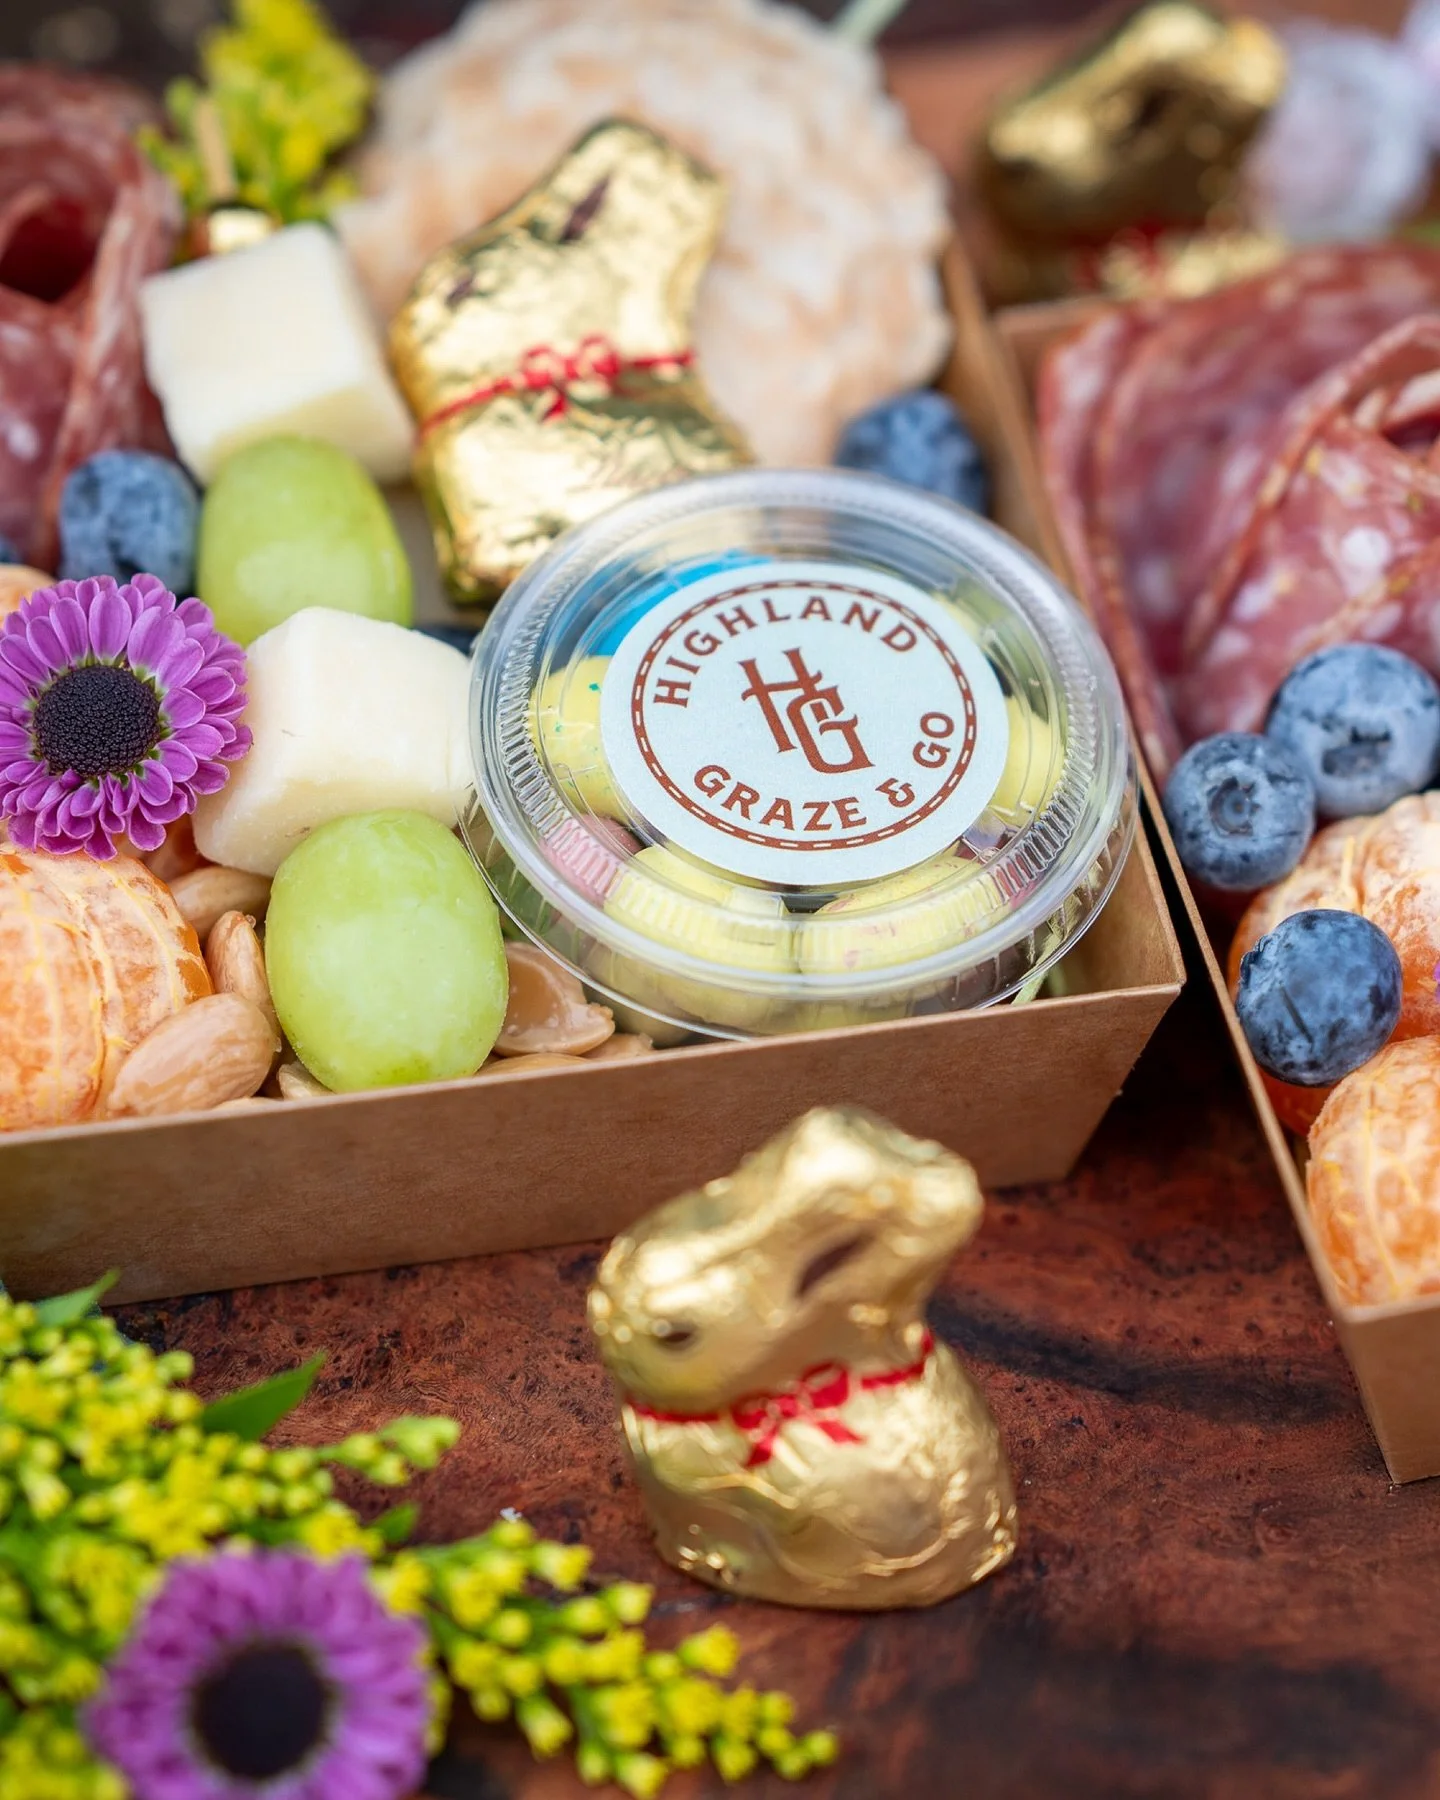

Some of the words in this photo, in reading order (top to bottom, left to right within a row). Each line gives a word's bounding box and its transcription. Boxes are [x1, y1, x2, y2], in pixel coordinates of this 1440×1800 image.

[653, 595, 918, 708] HIGHLAND
[693, 764, 868, 831] GRAZE
[875, 777, 916, 808] &
[912, 711, 955, 769] GO
